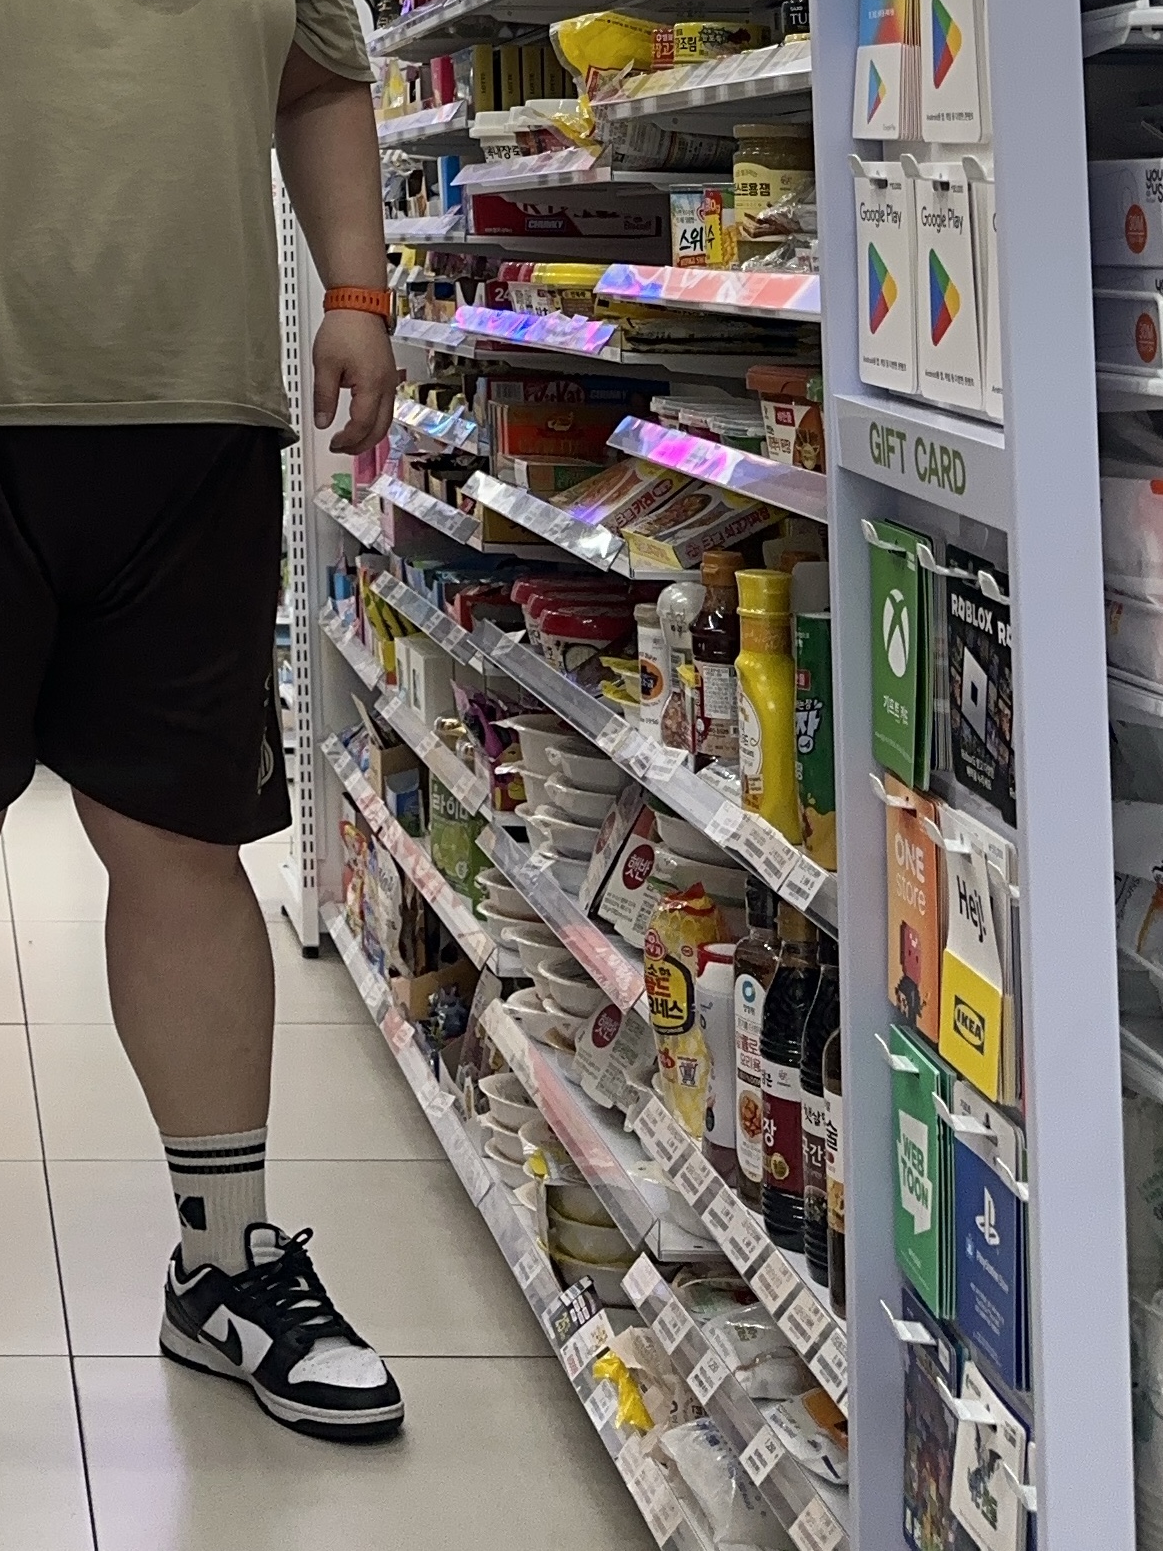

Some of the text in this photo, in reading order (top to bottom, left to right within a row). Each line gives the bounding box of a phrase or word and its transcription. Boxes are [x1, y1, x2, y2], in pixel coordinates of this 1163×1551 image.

[789, 12, 809, 25] TU
[859, 202, 902, 229] Google Play
[921, 206, 964, 235] Google Play
[868, 421, 967, 496] GIFT CARD
[950, 592, 993, 635] ROBLOX
[893, 831, 925, 885] ONE
[895, 872, 927, 917] store
[955, 874, 987, 944] Hej!
[955, 1008, 985, 1044] IKEA
[902, 1132, 925, 1176] WEB
[900, 1157, 930, 1211] TOON
